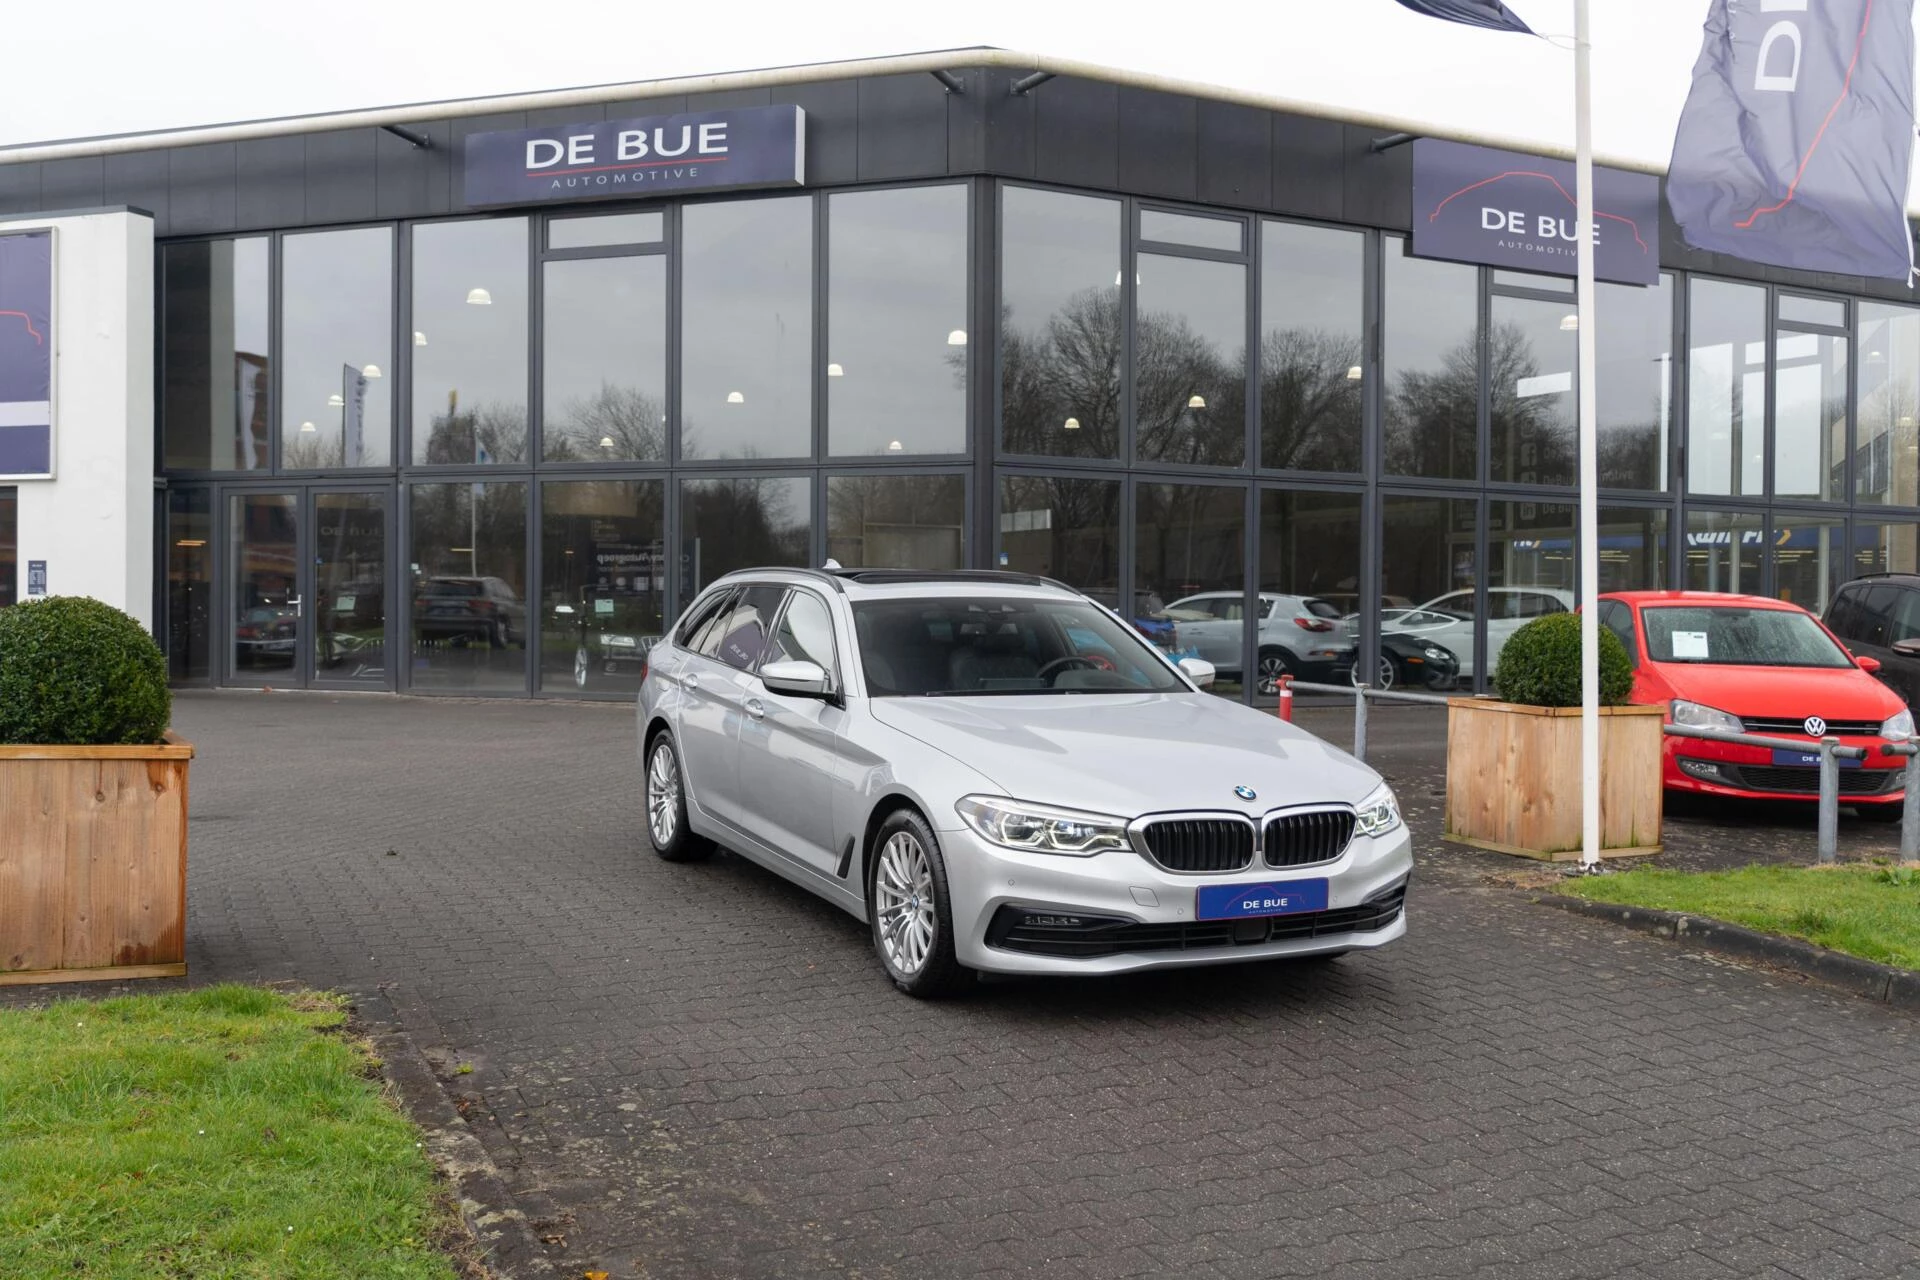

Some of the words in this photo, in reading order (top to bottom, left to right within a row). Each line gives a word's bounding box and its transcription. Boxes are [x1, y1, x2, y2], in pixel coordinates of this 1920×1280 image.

[1754, 0, 1808, 92] D
[525, 134, 595, 169] DE
[617, 122, 729, 161] BUE
[551, 167, 698, 189] AUTOMOTIVE
[1481, 207, 1526, 234] DE
[1498, 239, 1577, 257] AUTOMOTIV
[1243, 900, 1260, 909] DE
[1263, 898, 1288, 908] BUE
